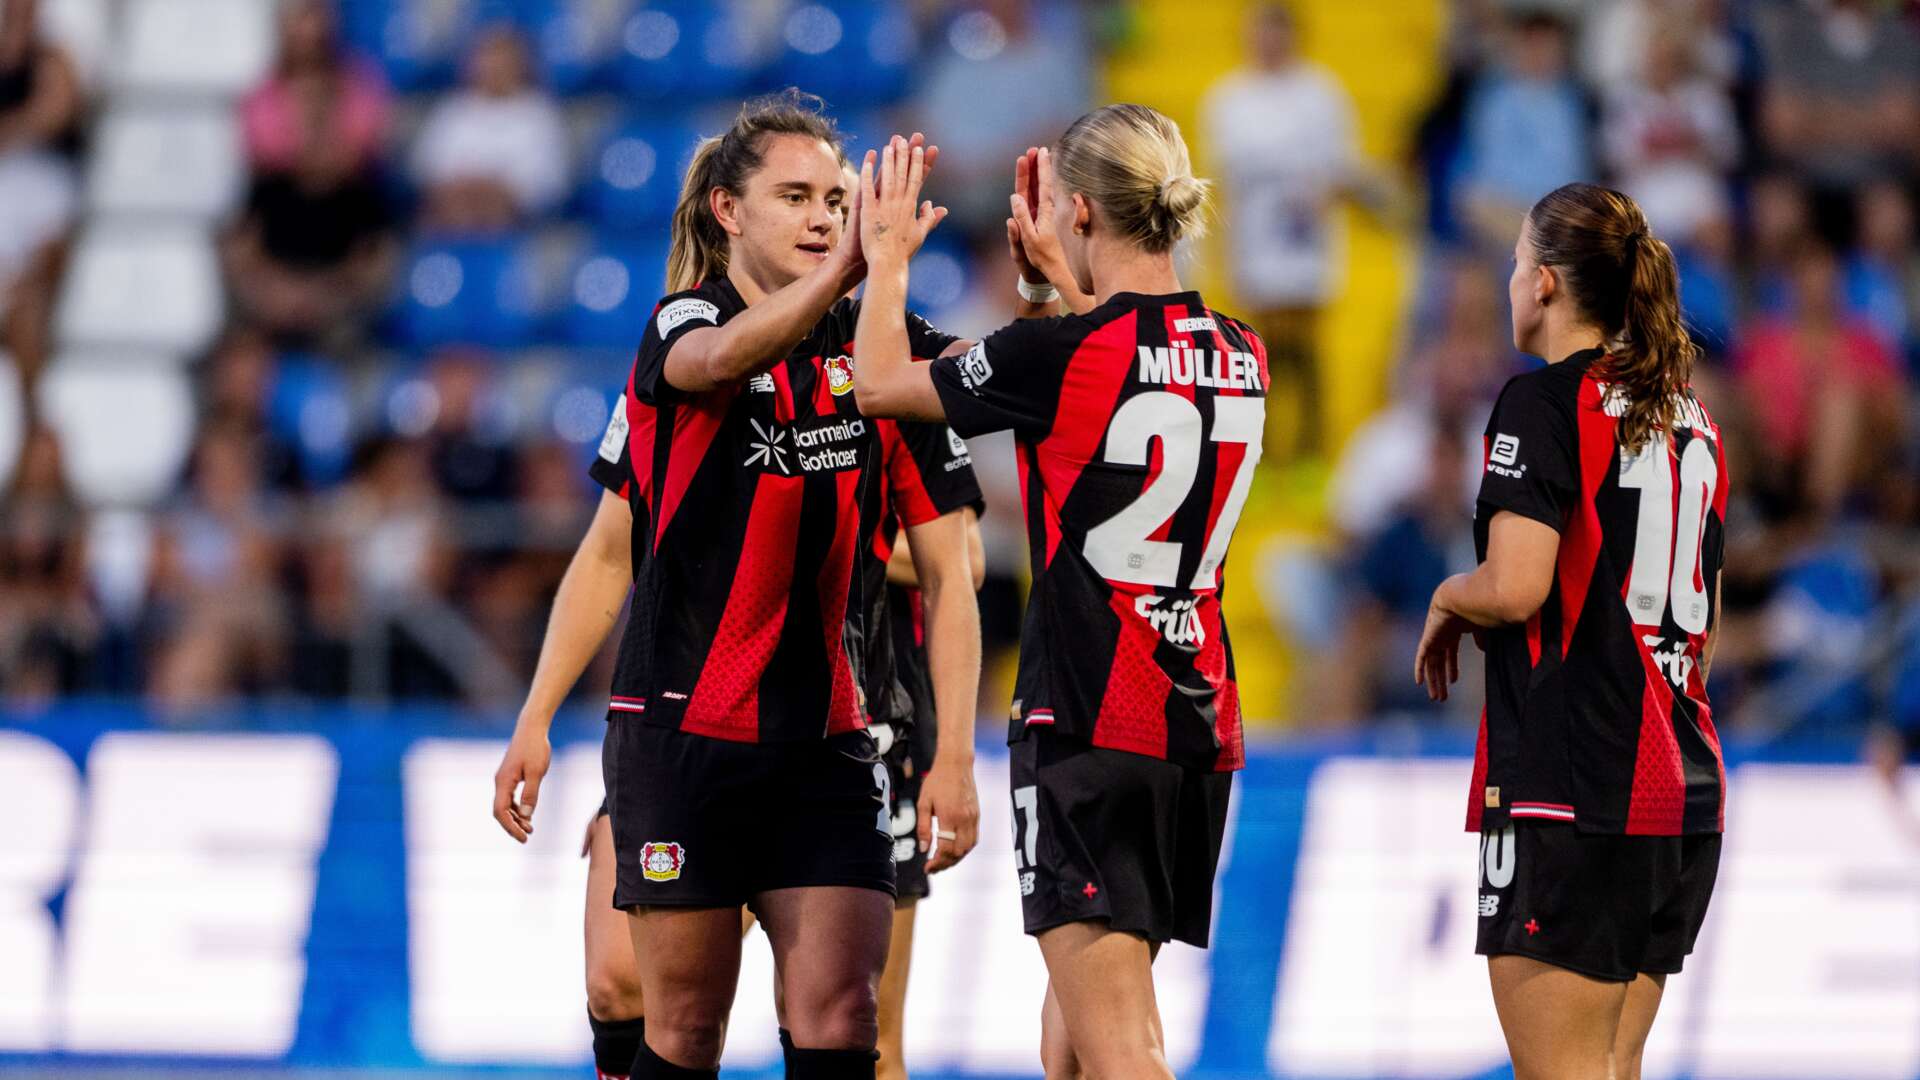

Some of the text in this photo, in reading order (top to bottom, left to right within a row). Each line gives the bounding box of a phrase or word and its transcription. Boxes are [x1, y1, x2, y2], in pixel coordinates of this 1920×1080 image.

[1137, 340, 1262, 390] MÜLLER
[798, 448, 858, 472] Gothaer
[1082, 391, 1265, 589] 27
[1618, 430, 1718, 635] 10
[1011, 785, 1040, 869] 7
